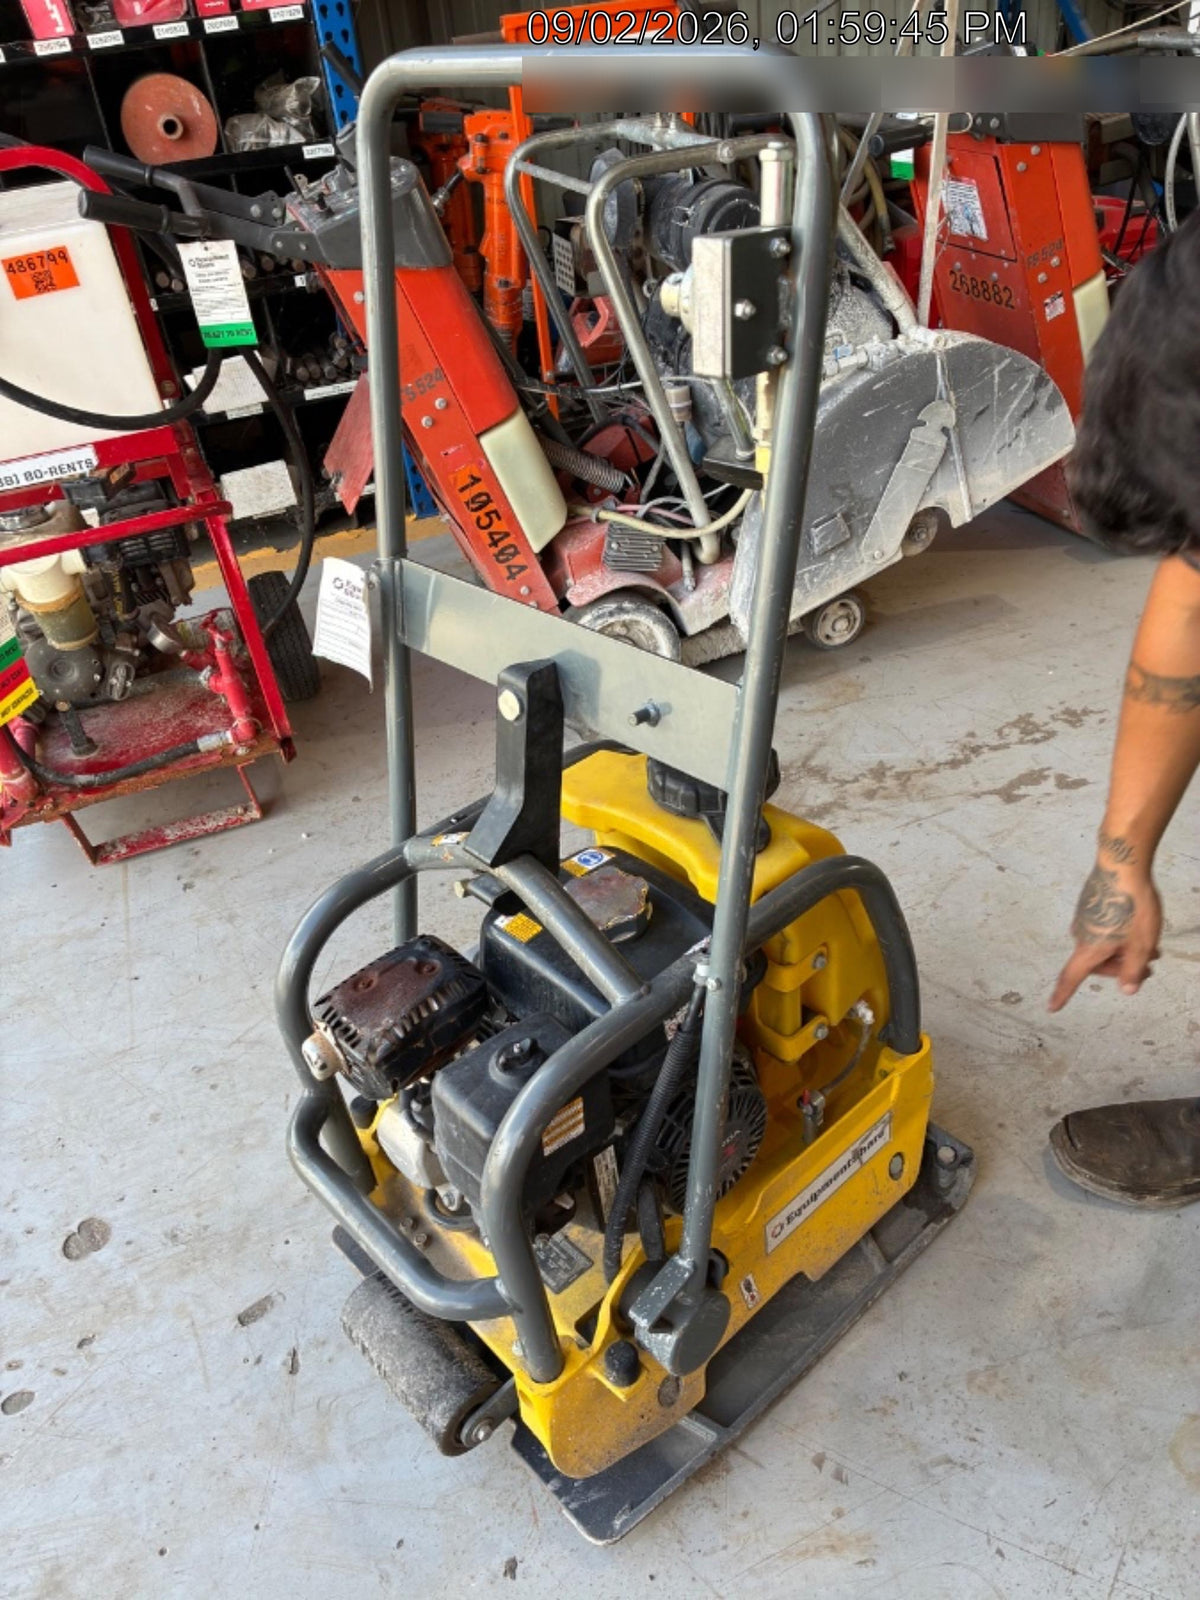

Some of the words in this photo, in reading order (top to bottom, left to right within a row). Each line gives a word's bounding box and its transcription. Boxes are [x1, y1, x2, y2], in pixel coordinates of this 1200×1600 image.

[6, 250, 69, 275] 486799
[949, 269, 1016, 310] 268882
[457, 474, 530, 582] 105404
